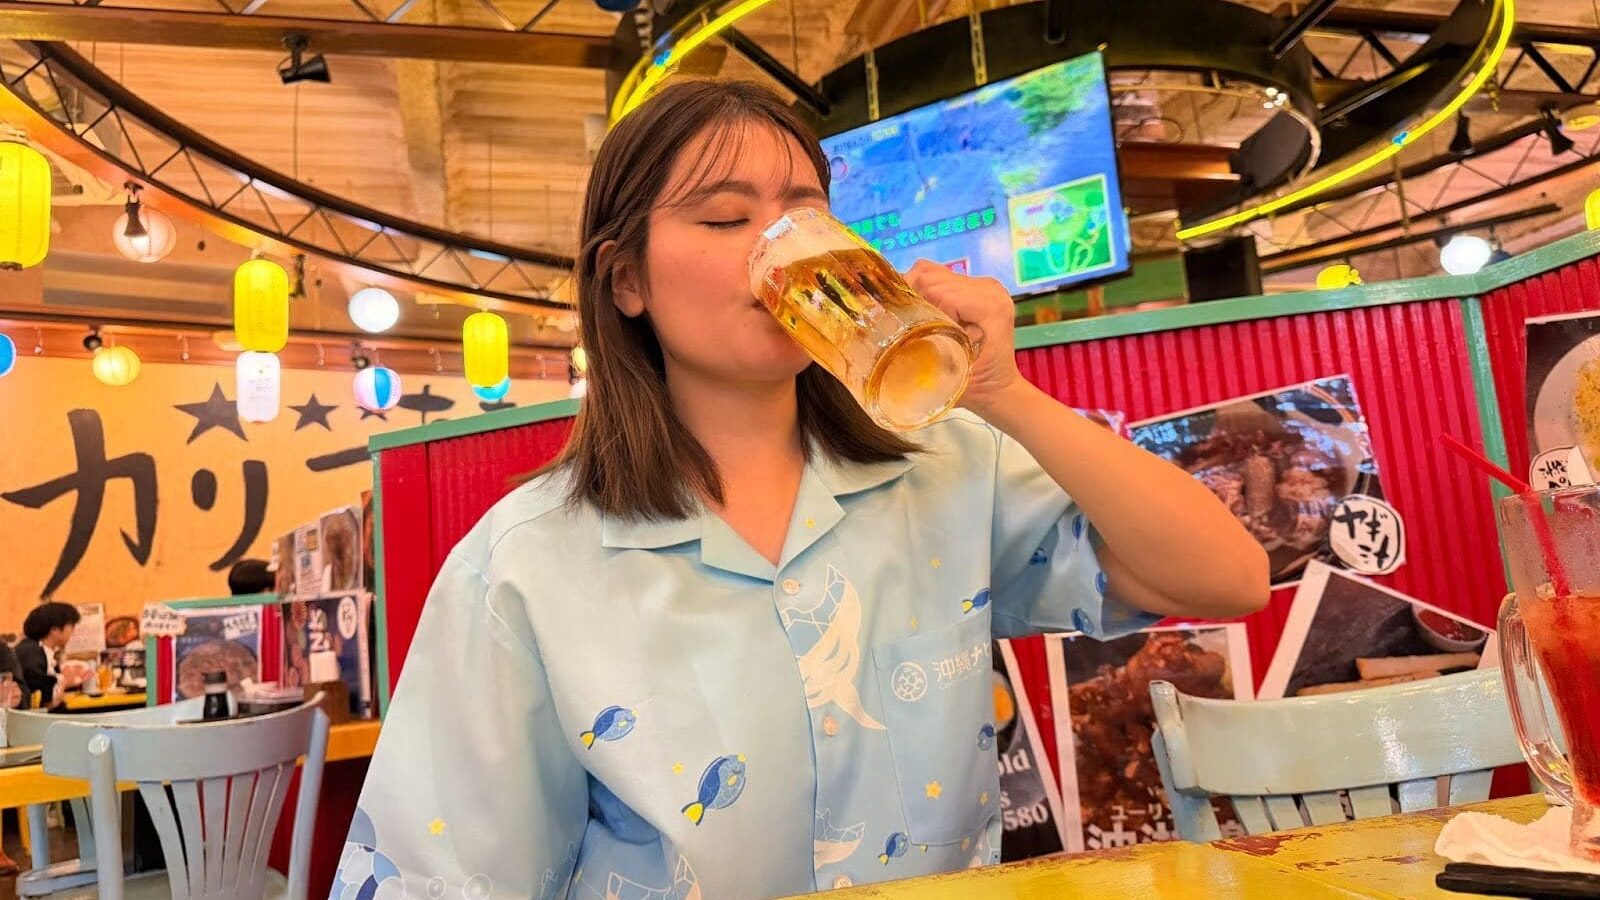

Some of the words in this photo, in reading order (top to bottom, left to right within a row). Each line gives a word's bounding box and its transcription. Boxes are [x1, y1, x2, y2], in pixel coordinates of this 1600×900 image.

[1003, 803, 1049, 832] 580
[1110, 802, 1174, 822] ユーリ
